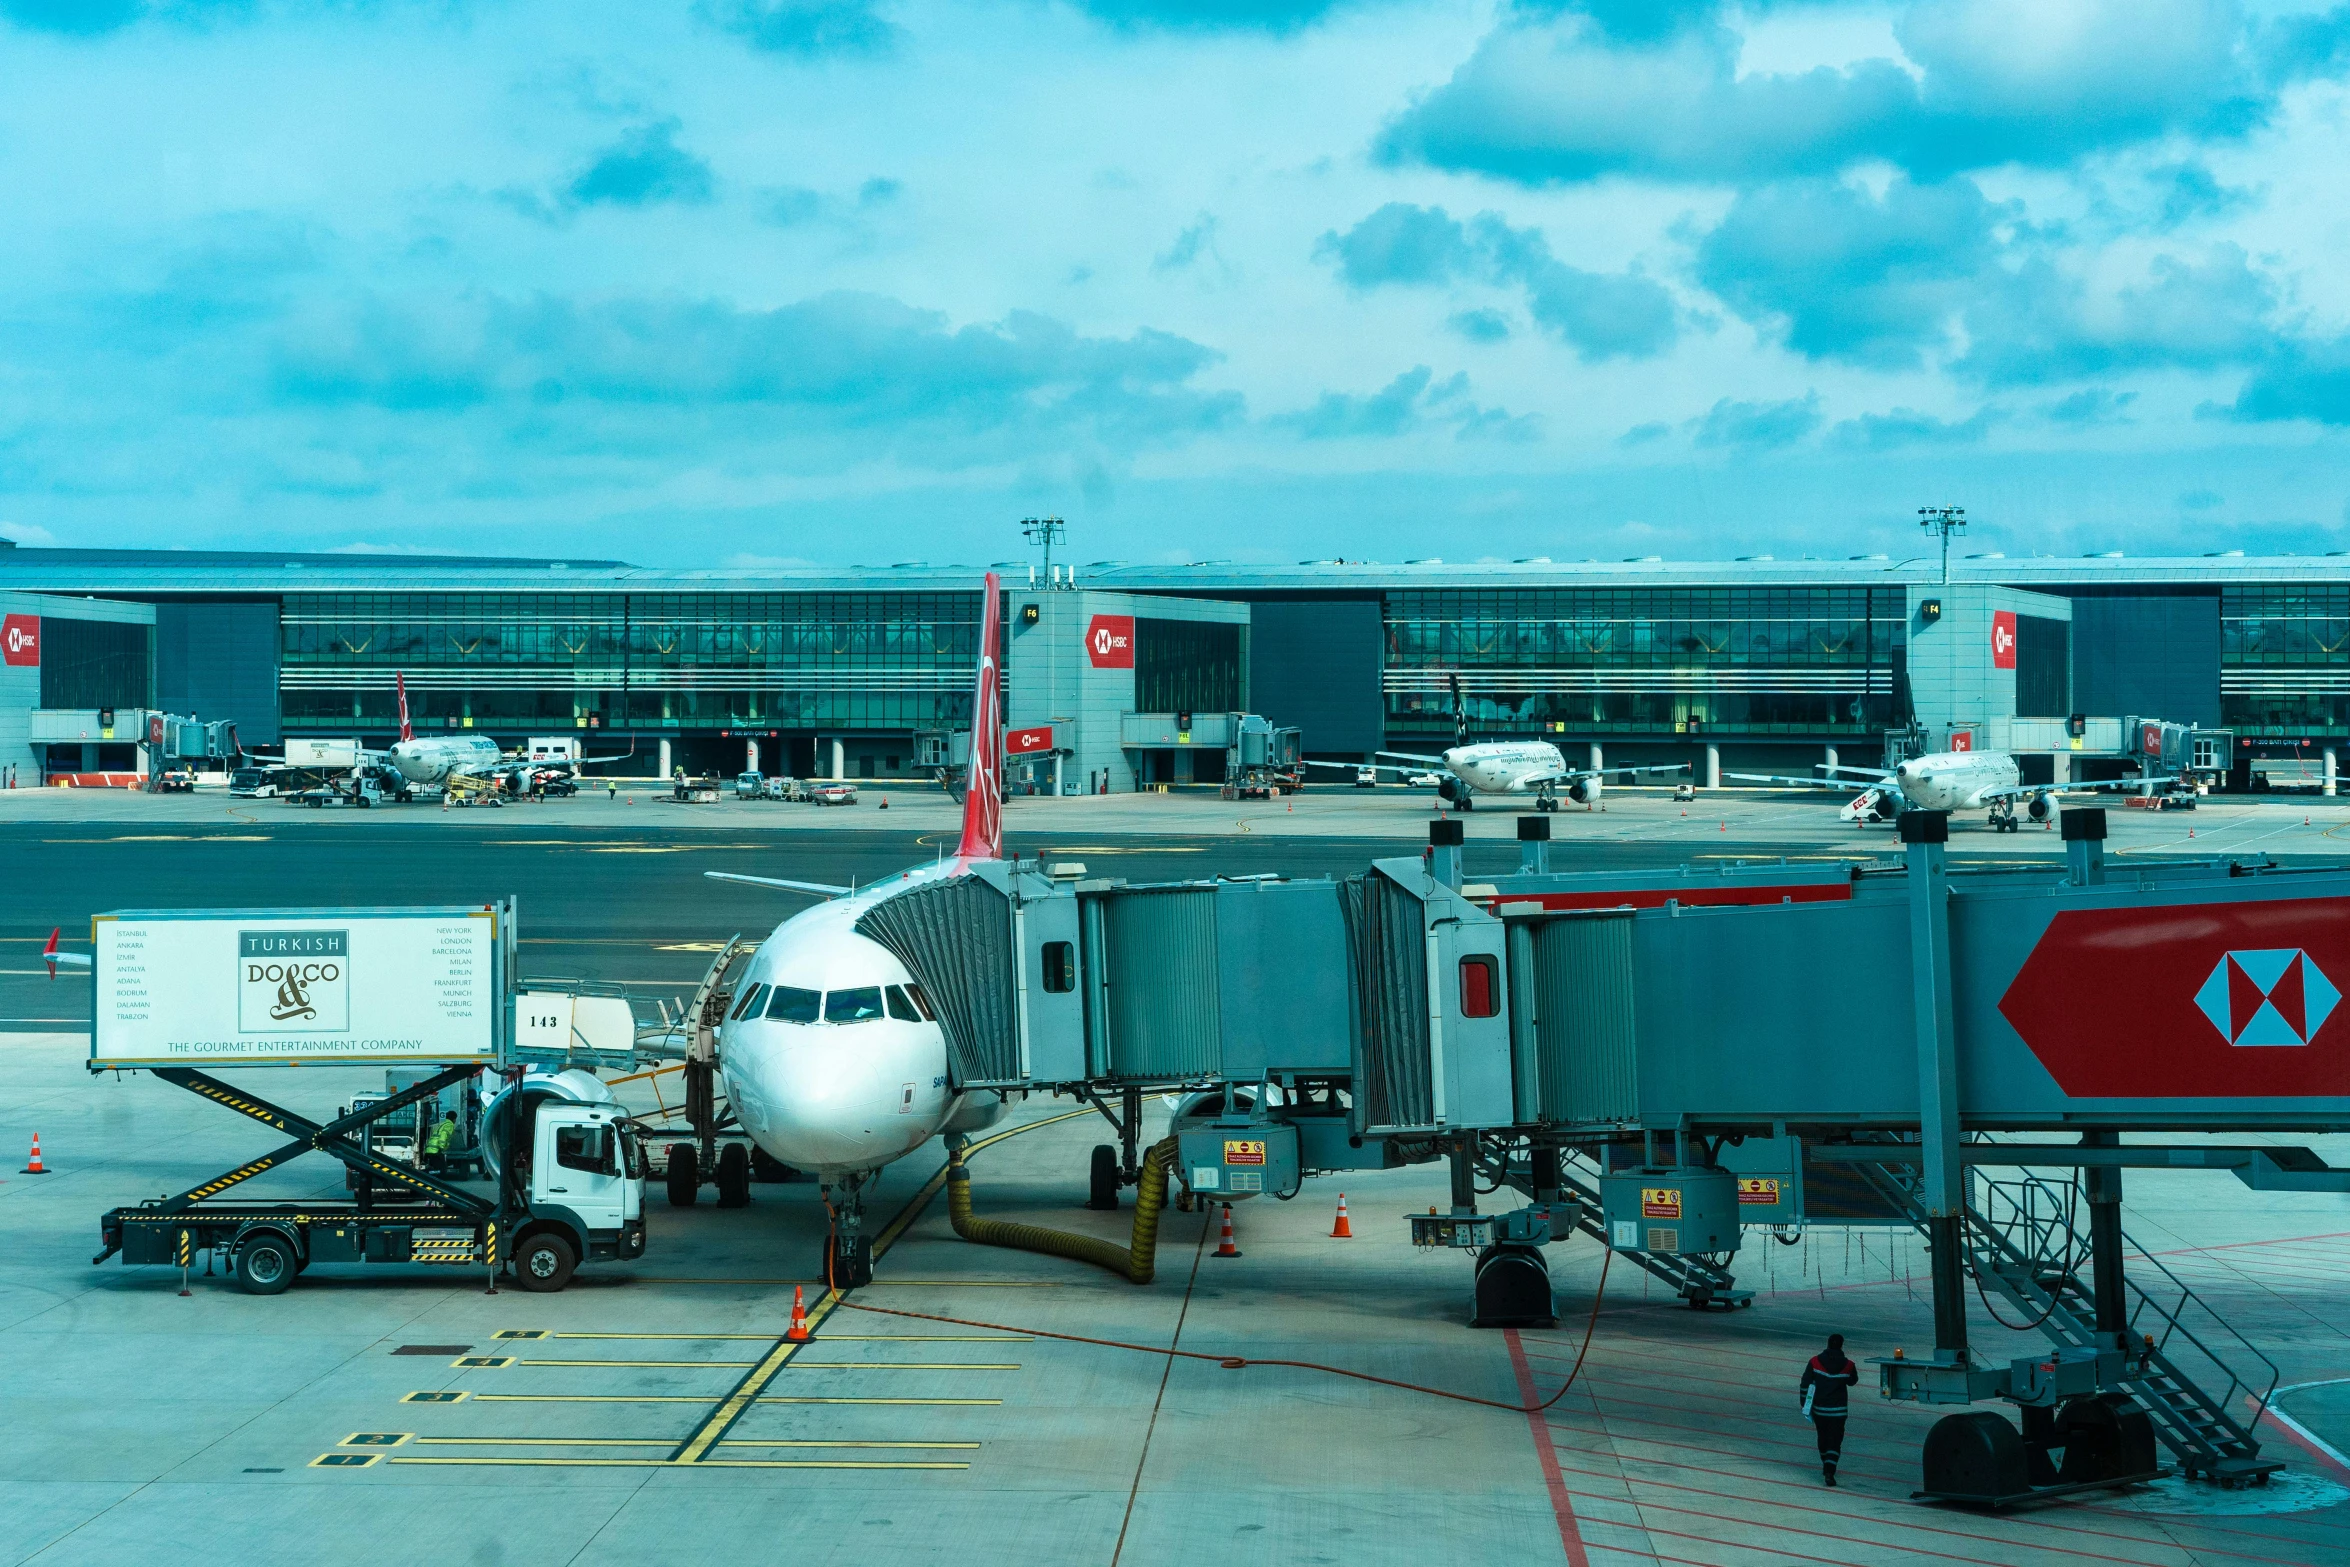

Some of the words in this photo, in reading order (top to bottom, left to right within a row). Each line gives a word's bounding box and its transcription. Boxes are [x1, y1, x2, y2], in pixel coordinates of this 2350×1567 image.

[1027, 609, 1037, 618] F6
[1930, 605, 1939, 614] F4
[22, 635, 35, 647] HSBC
[1122, 636, 1137, 648] HSBC
[248, 938, 339, 951] TURKISH
[168, 1042, 190, 1053] THE
[194, 1040, 254, 1053] GOURMET
[258, 1040, 357, 1052] ENTERTAINMENT
[361, 1039, 423, 1051] COMPANY
[427, 1393, 444, 1401] 3
[366, 1435, 385, 1444] 2
[340, 1456, 353, 1465] 1
